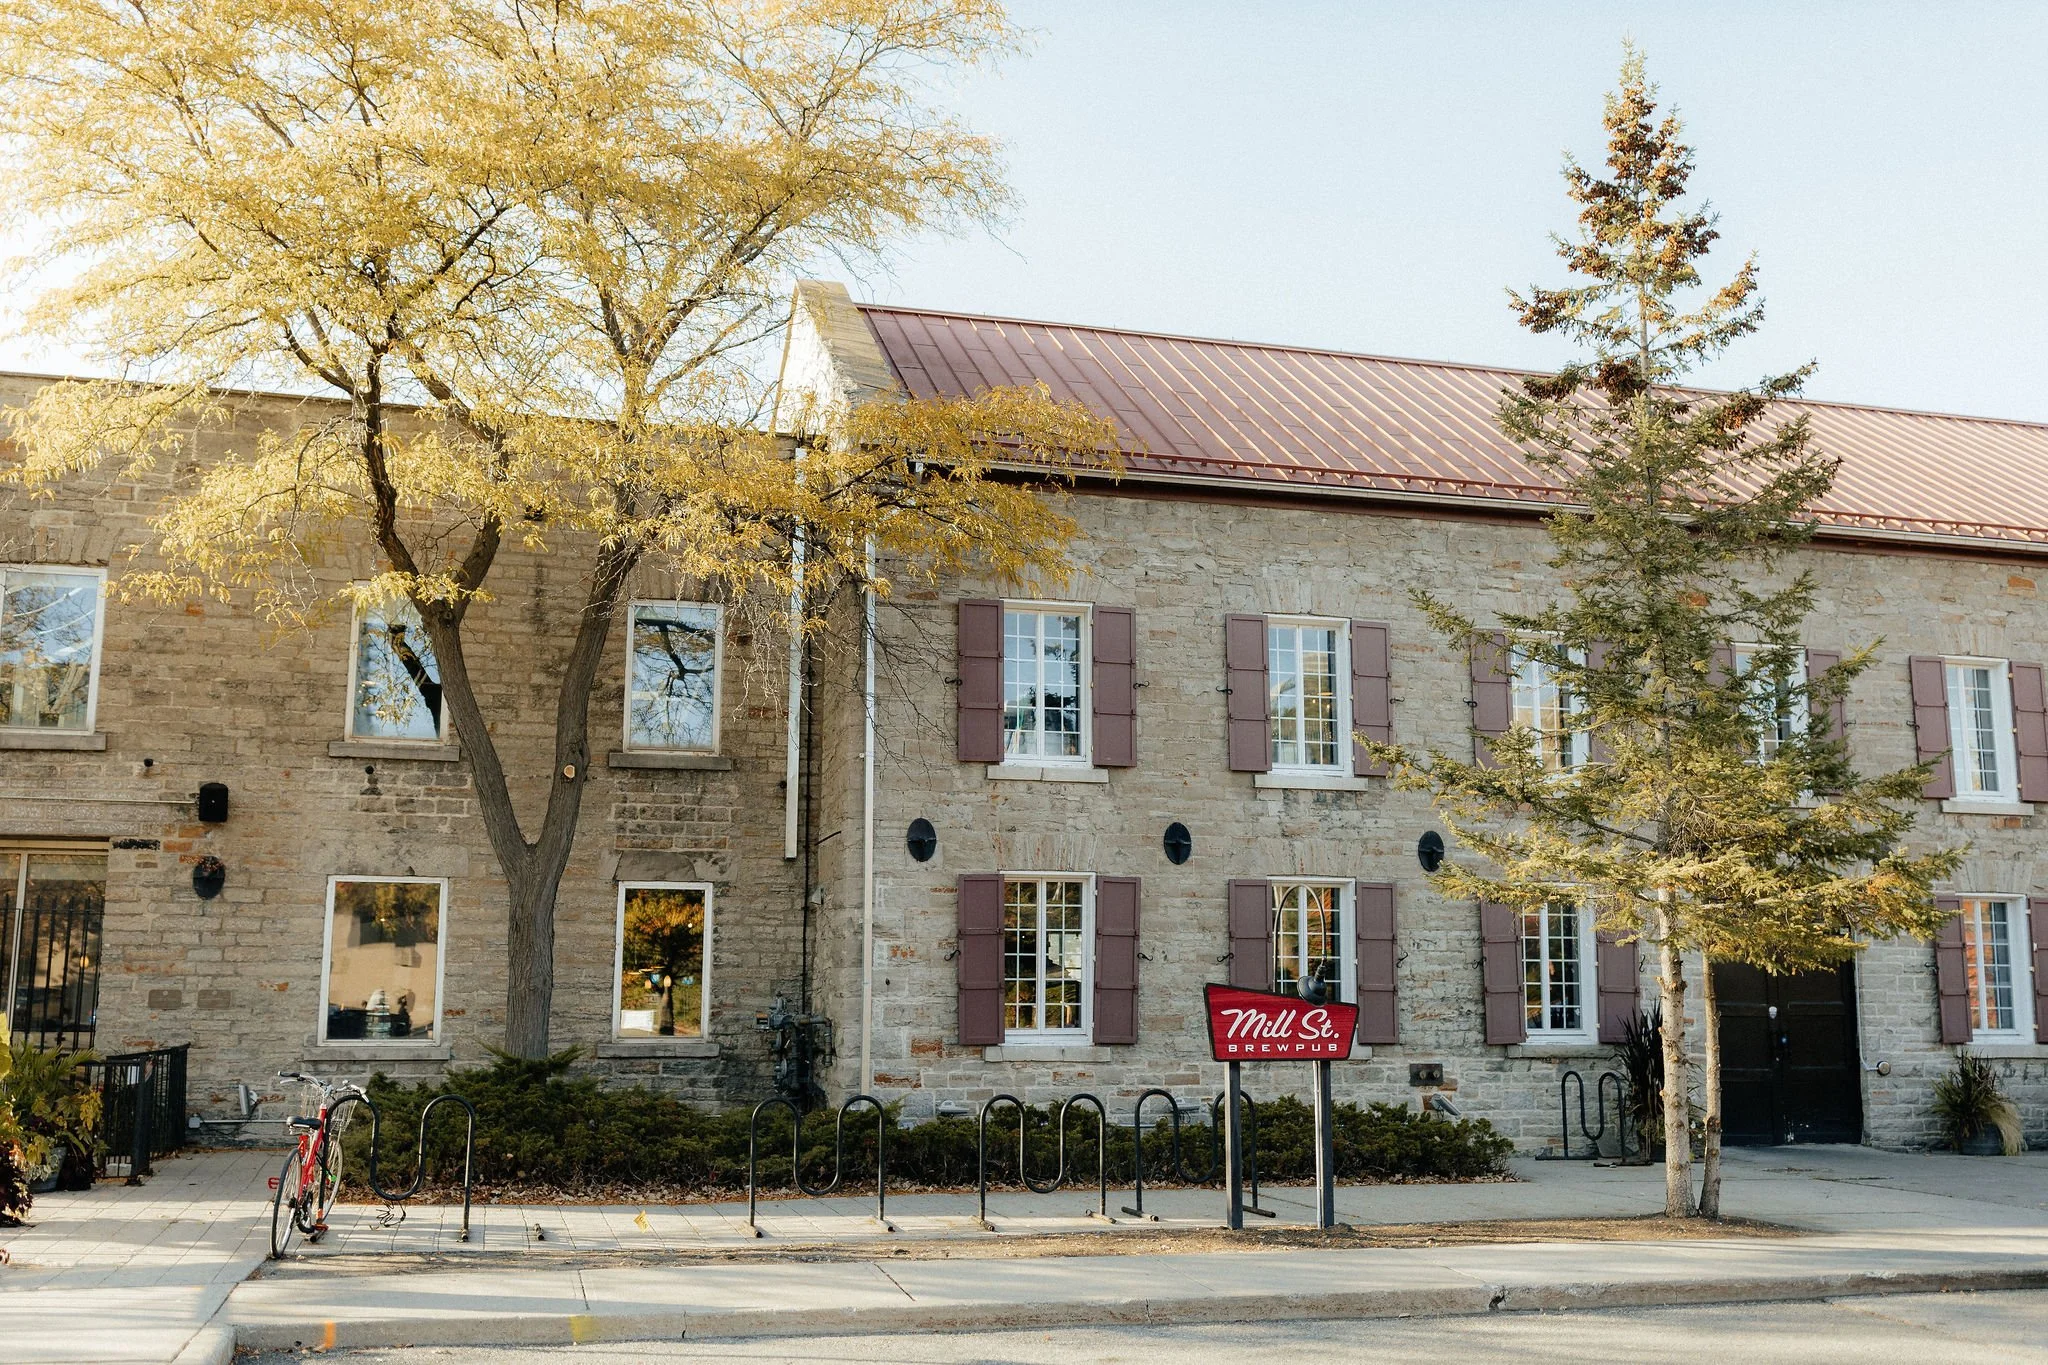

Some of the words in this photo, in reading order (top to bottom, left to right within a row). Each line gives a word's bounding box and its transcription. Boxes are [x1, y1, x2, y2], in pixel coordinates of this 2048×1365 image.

[1220, 1008, 1297, 1040] Mill
[1297, 1008, 1340, 1040] St.
[1228, 1043, 1338, 1053] BREWPUB
